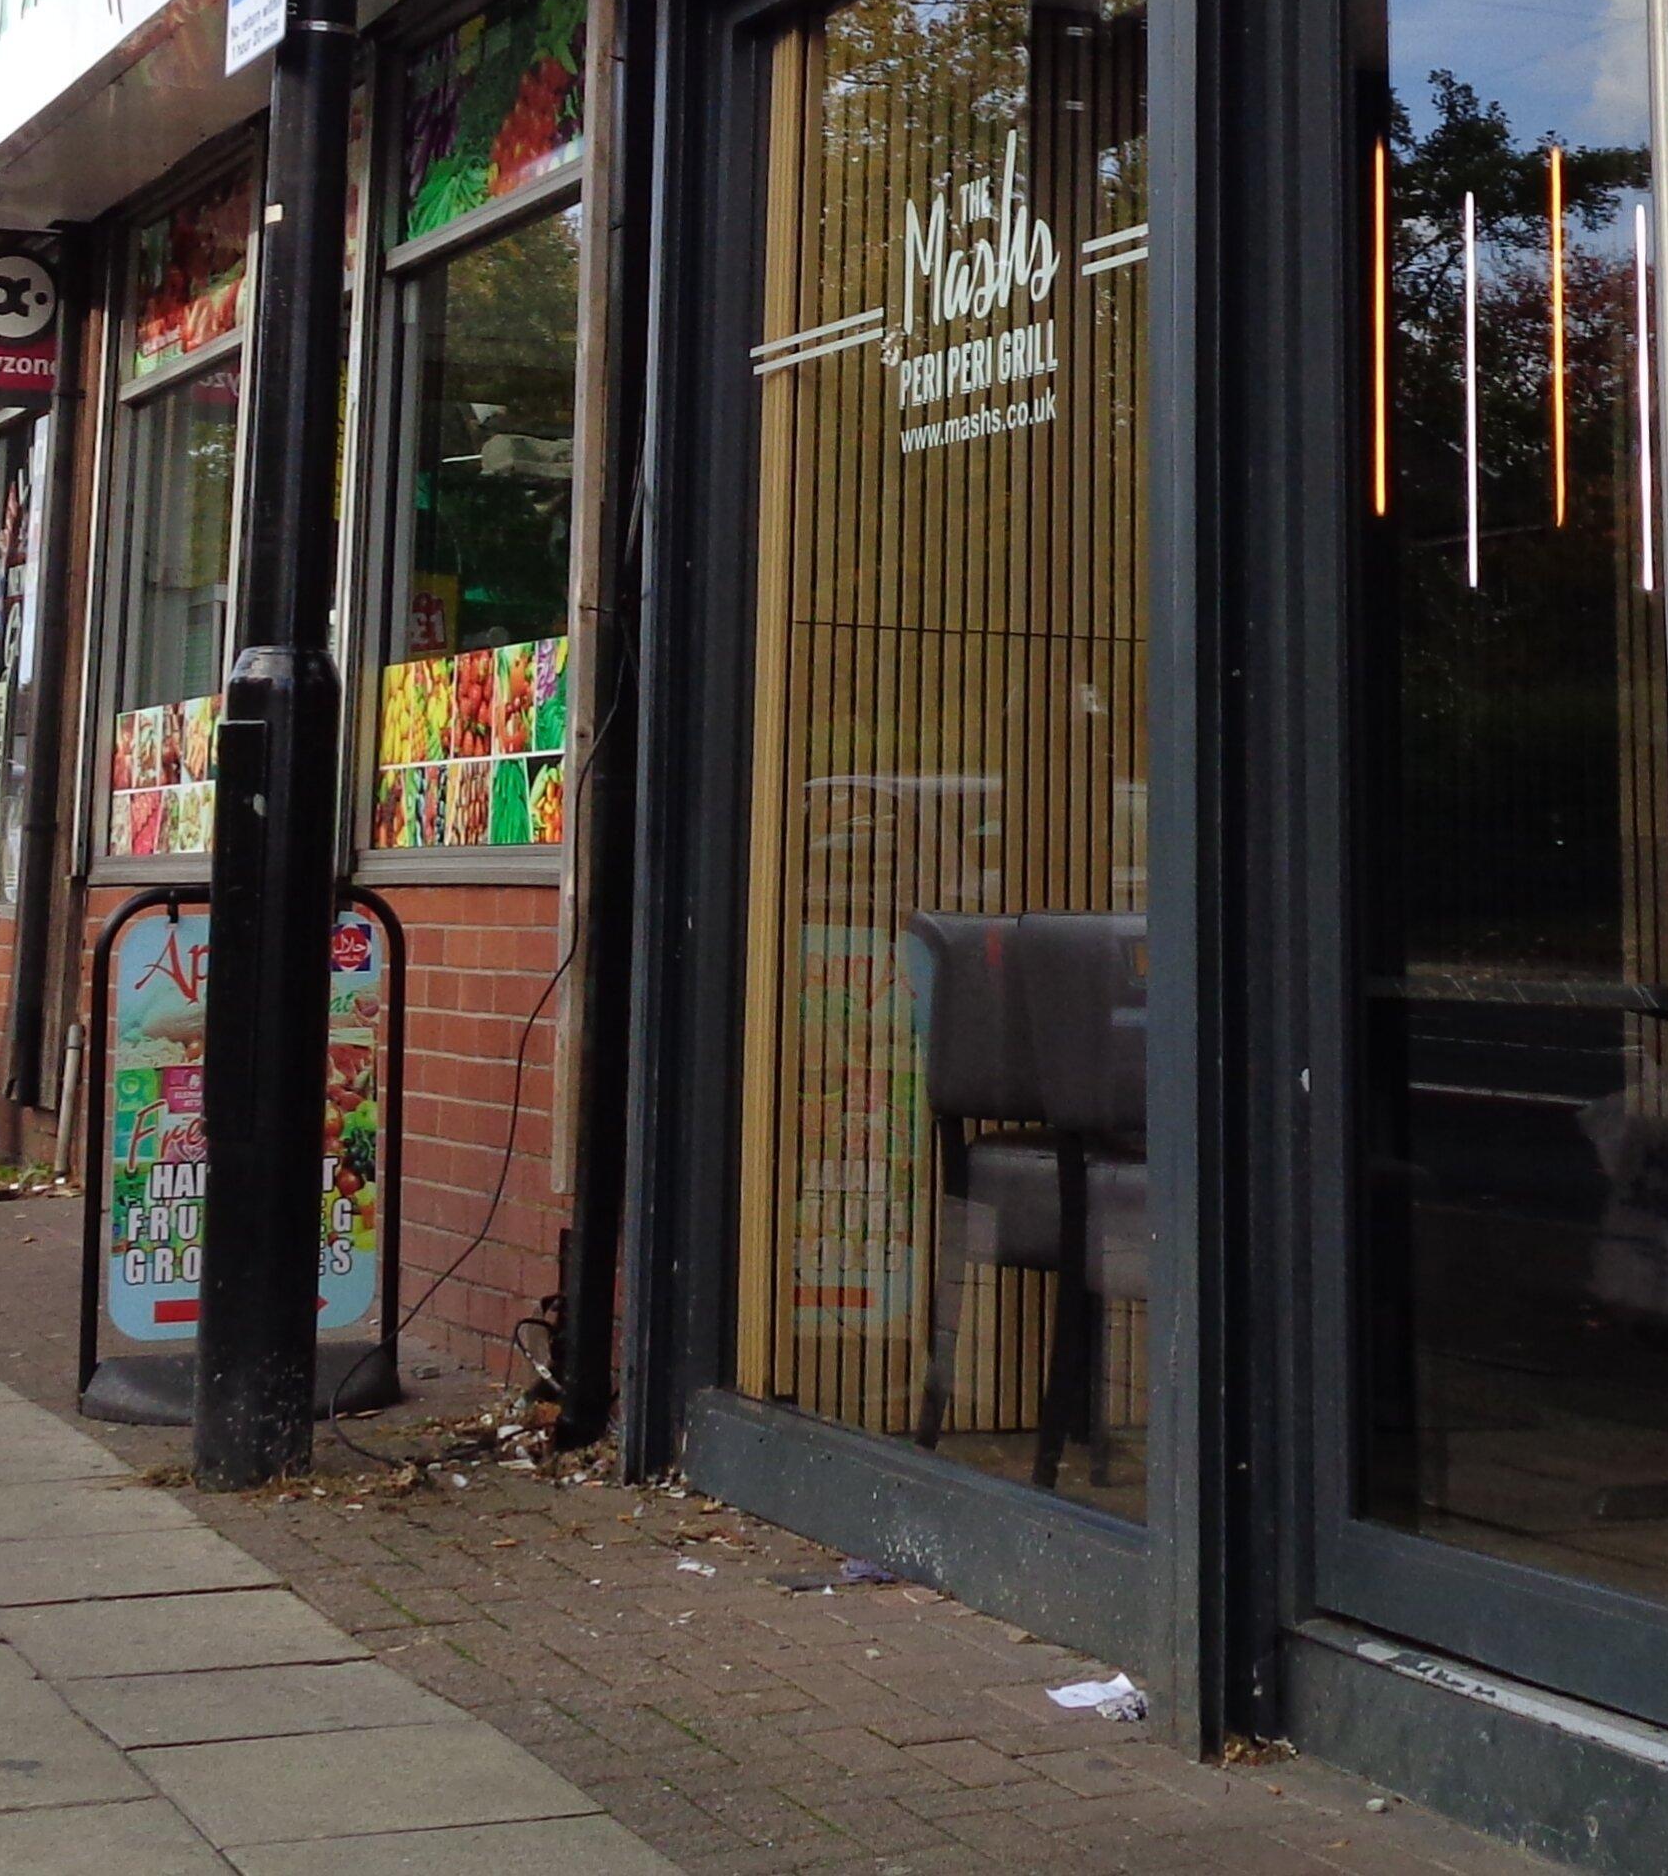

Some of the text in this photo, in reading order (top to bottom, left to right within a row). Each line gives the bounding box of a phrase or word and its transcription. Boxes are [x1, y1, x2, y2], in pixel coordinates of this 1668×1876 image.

[903, 129, 1061, 335] Mashs
[959, 175, 991, 224] THE
[899, 319, 1059, 411] PERI PERI GRILL
[900, 386, 1058, 454] www.mashs.co.uk
[134, 930, 211, 1004] Ap
[127, 1100, 206, 1174] Fre
[128, 1204, 200, 1241] FRU
